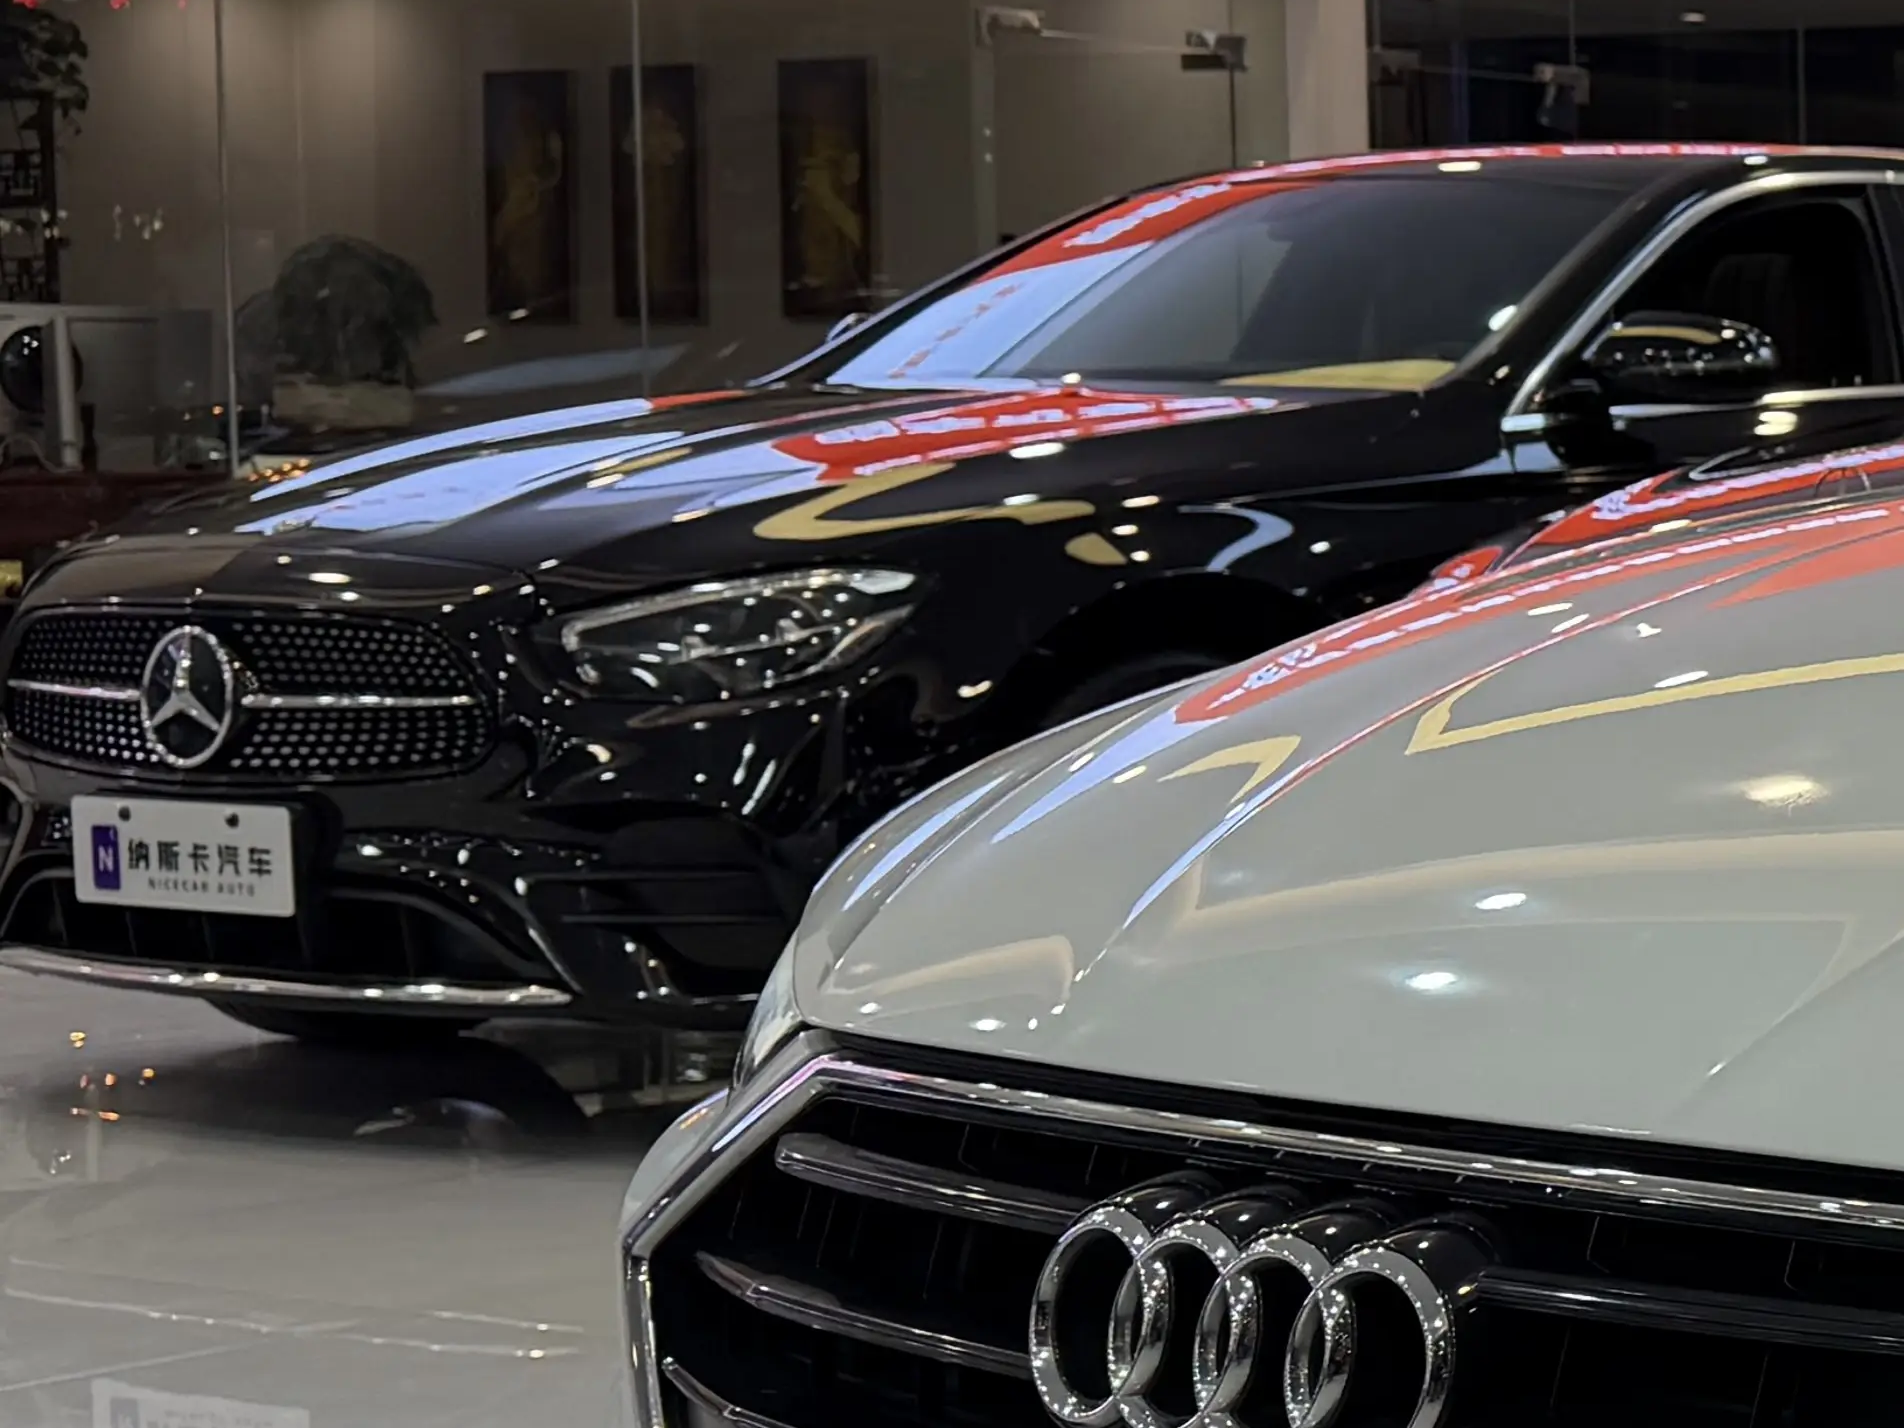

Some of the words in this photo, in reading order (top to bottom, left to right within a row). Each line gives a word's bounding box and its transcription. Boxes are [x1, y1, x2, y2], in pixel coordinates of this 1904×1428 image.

[127, 838, 273, 878] 纳斯卡汽车
